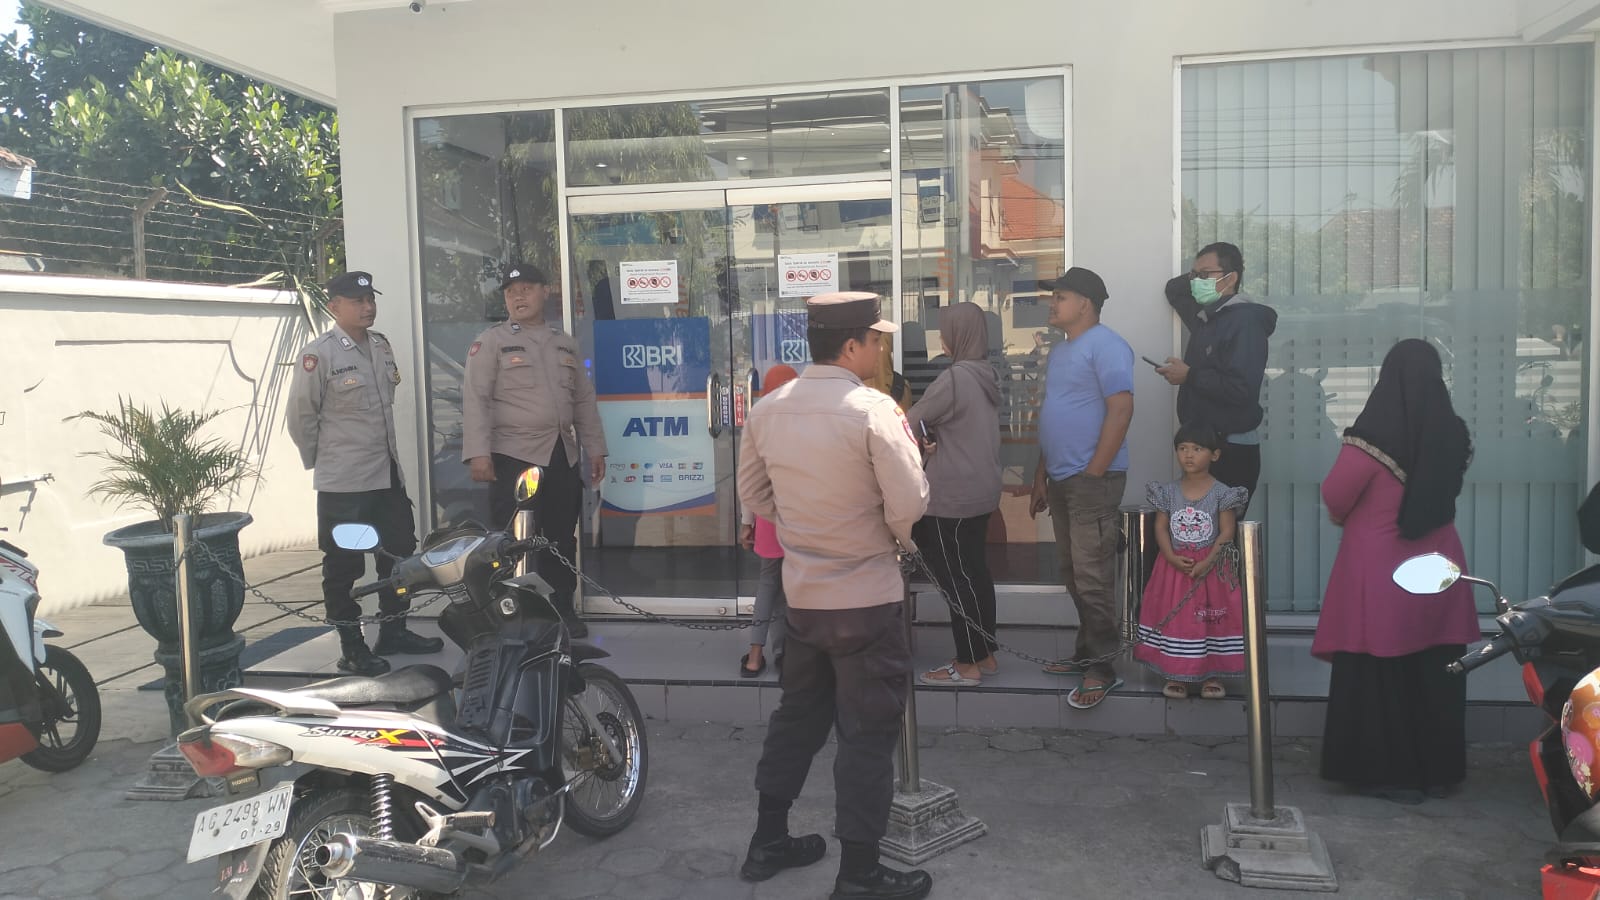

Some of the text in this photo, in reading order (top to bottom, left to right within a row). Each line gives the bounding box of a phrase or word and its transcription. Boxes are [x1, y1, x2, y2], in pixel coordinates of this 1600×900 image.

[646, 345, 683, 366] BRI
[622, 416, 689, 437] ATM
[362, 729, 410, 745] X
[222, 801, 260, 827] 2498
[267, 791, 289, 814] WN
